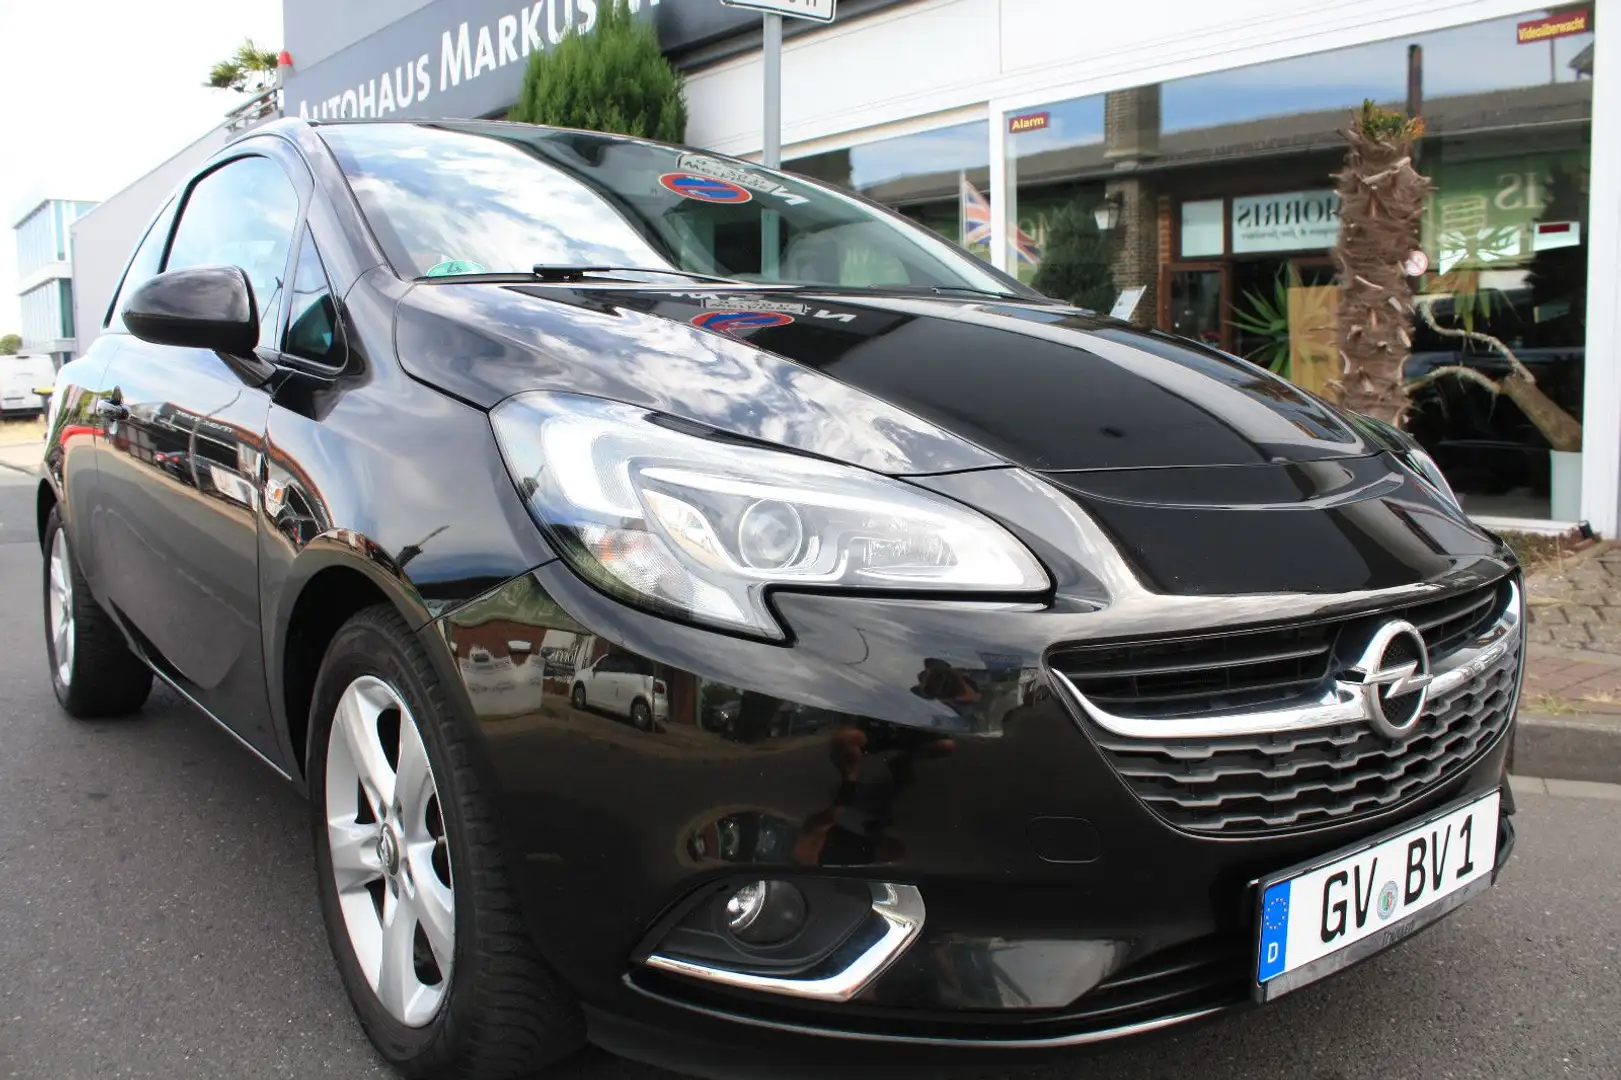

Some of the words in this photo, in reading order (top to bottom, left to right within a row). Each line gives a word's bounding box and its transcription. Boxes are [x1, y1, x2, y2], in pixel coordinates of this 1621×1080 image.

[440, 0, 597, 92] MARKUS
[1011, 116, 1045, 131] Alarm
[1320, 857, 1378, 943] GV
[1404, 824, 1452, 907] BV
[1456, 814, 1474, 879] 1
[1267, 942, 1279, 964] D
